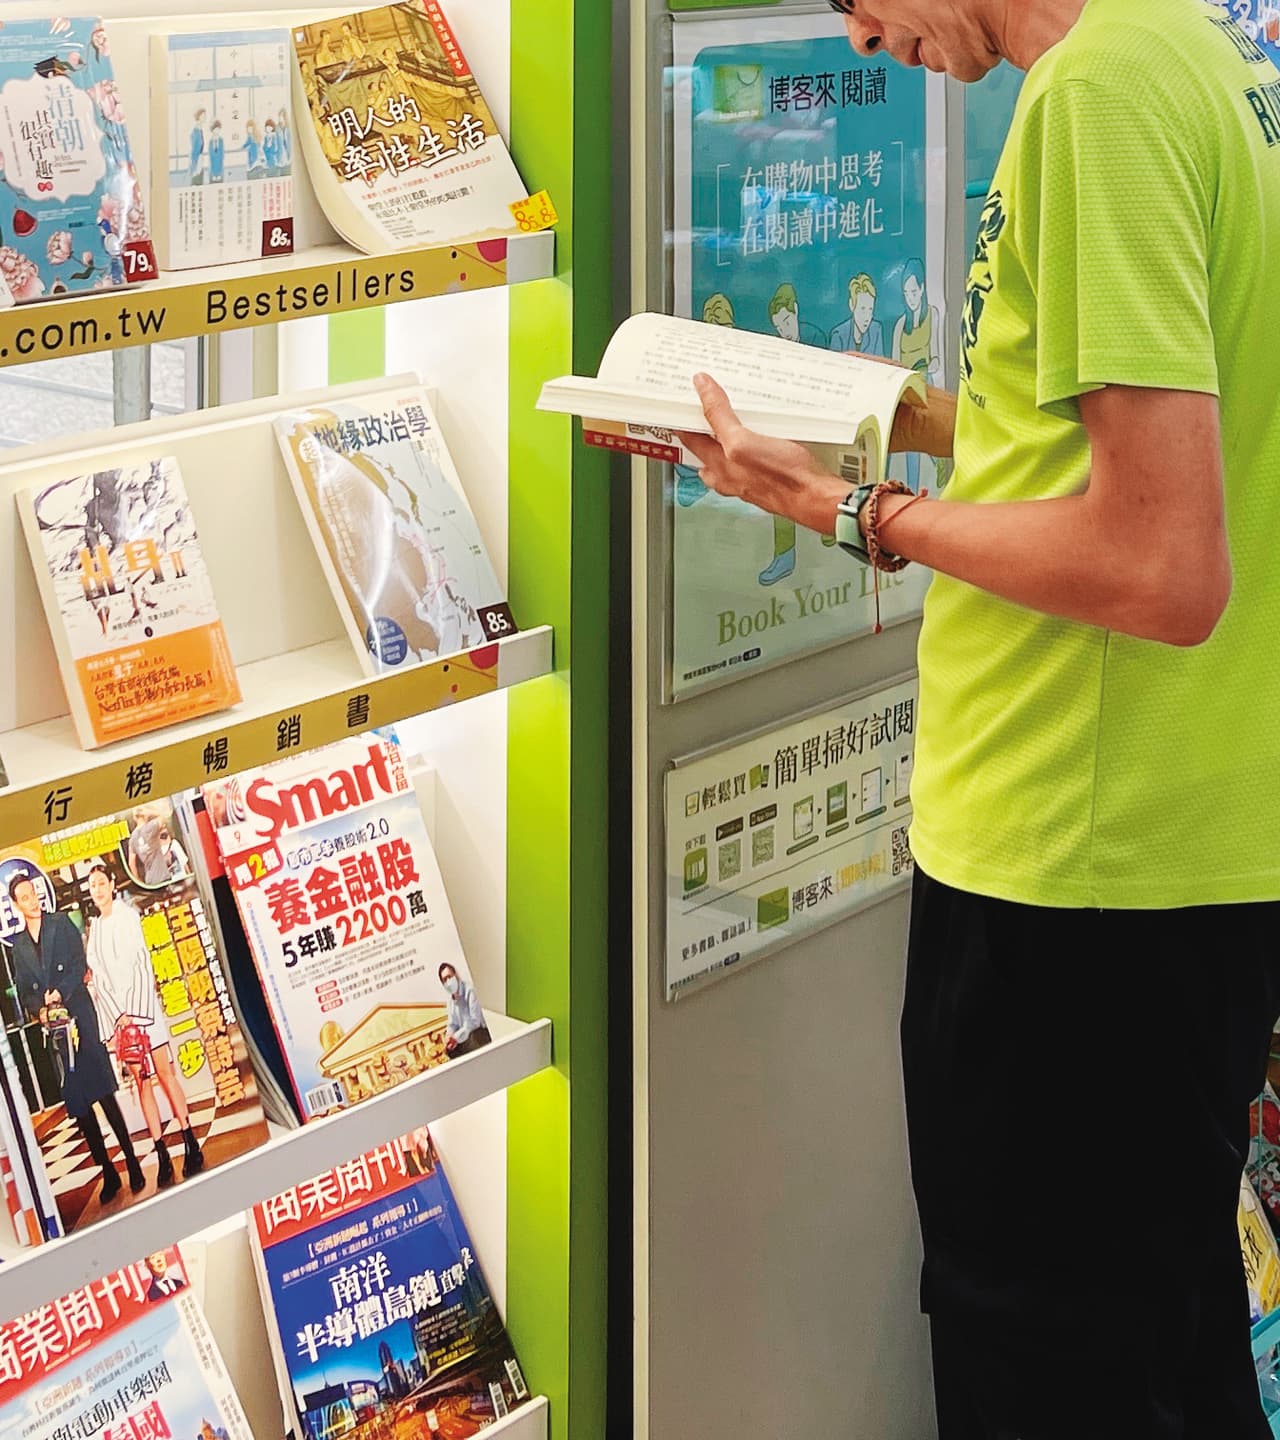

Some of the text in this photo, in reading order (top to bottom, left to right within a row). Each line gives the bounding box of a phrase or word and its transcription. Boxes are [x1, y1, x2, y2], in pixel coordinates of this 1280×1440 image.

[327, 94, 421, 145] 明人的
[341, 114, 486, 188] 率性生活
[740, 151, 884, 203] 在購物中思考
[740, 198, 884, 257] 在閱讀中進化
[207, 266, 416, 325] Bestsellers
[717, 596, 786, 647] Book
[794, 580, 851, 620] Your
[246, 743, 392, 839] Smart
[702, 772, 747, 812] 輕鬆買
[264, 837, 420, 935] 養金融股
[791, 874, 834, 913] 博客來
[282, 890, 428, 968] 5年賺2200萬
[329, 1251, 392, 1309] 南洋
[296, 1269, 442, 1364] 半導體島鏈
